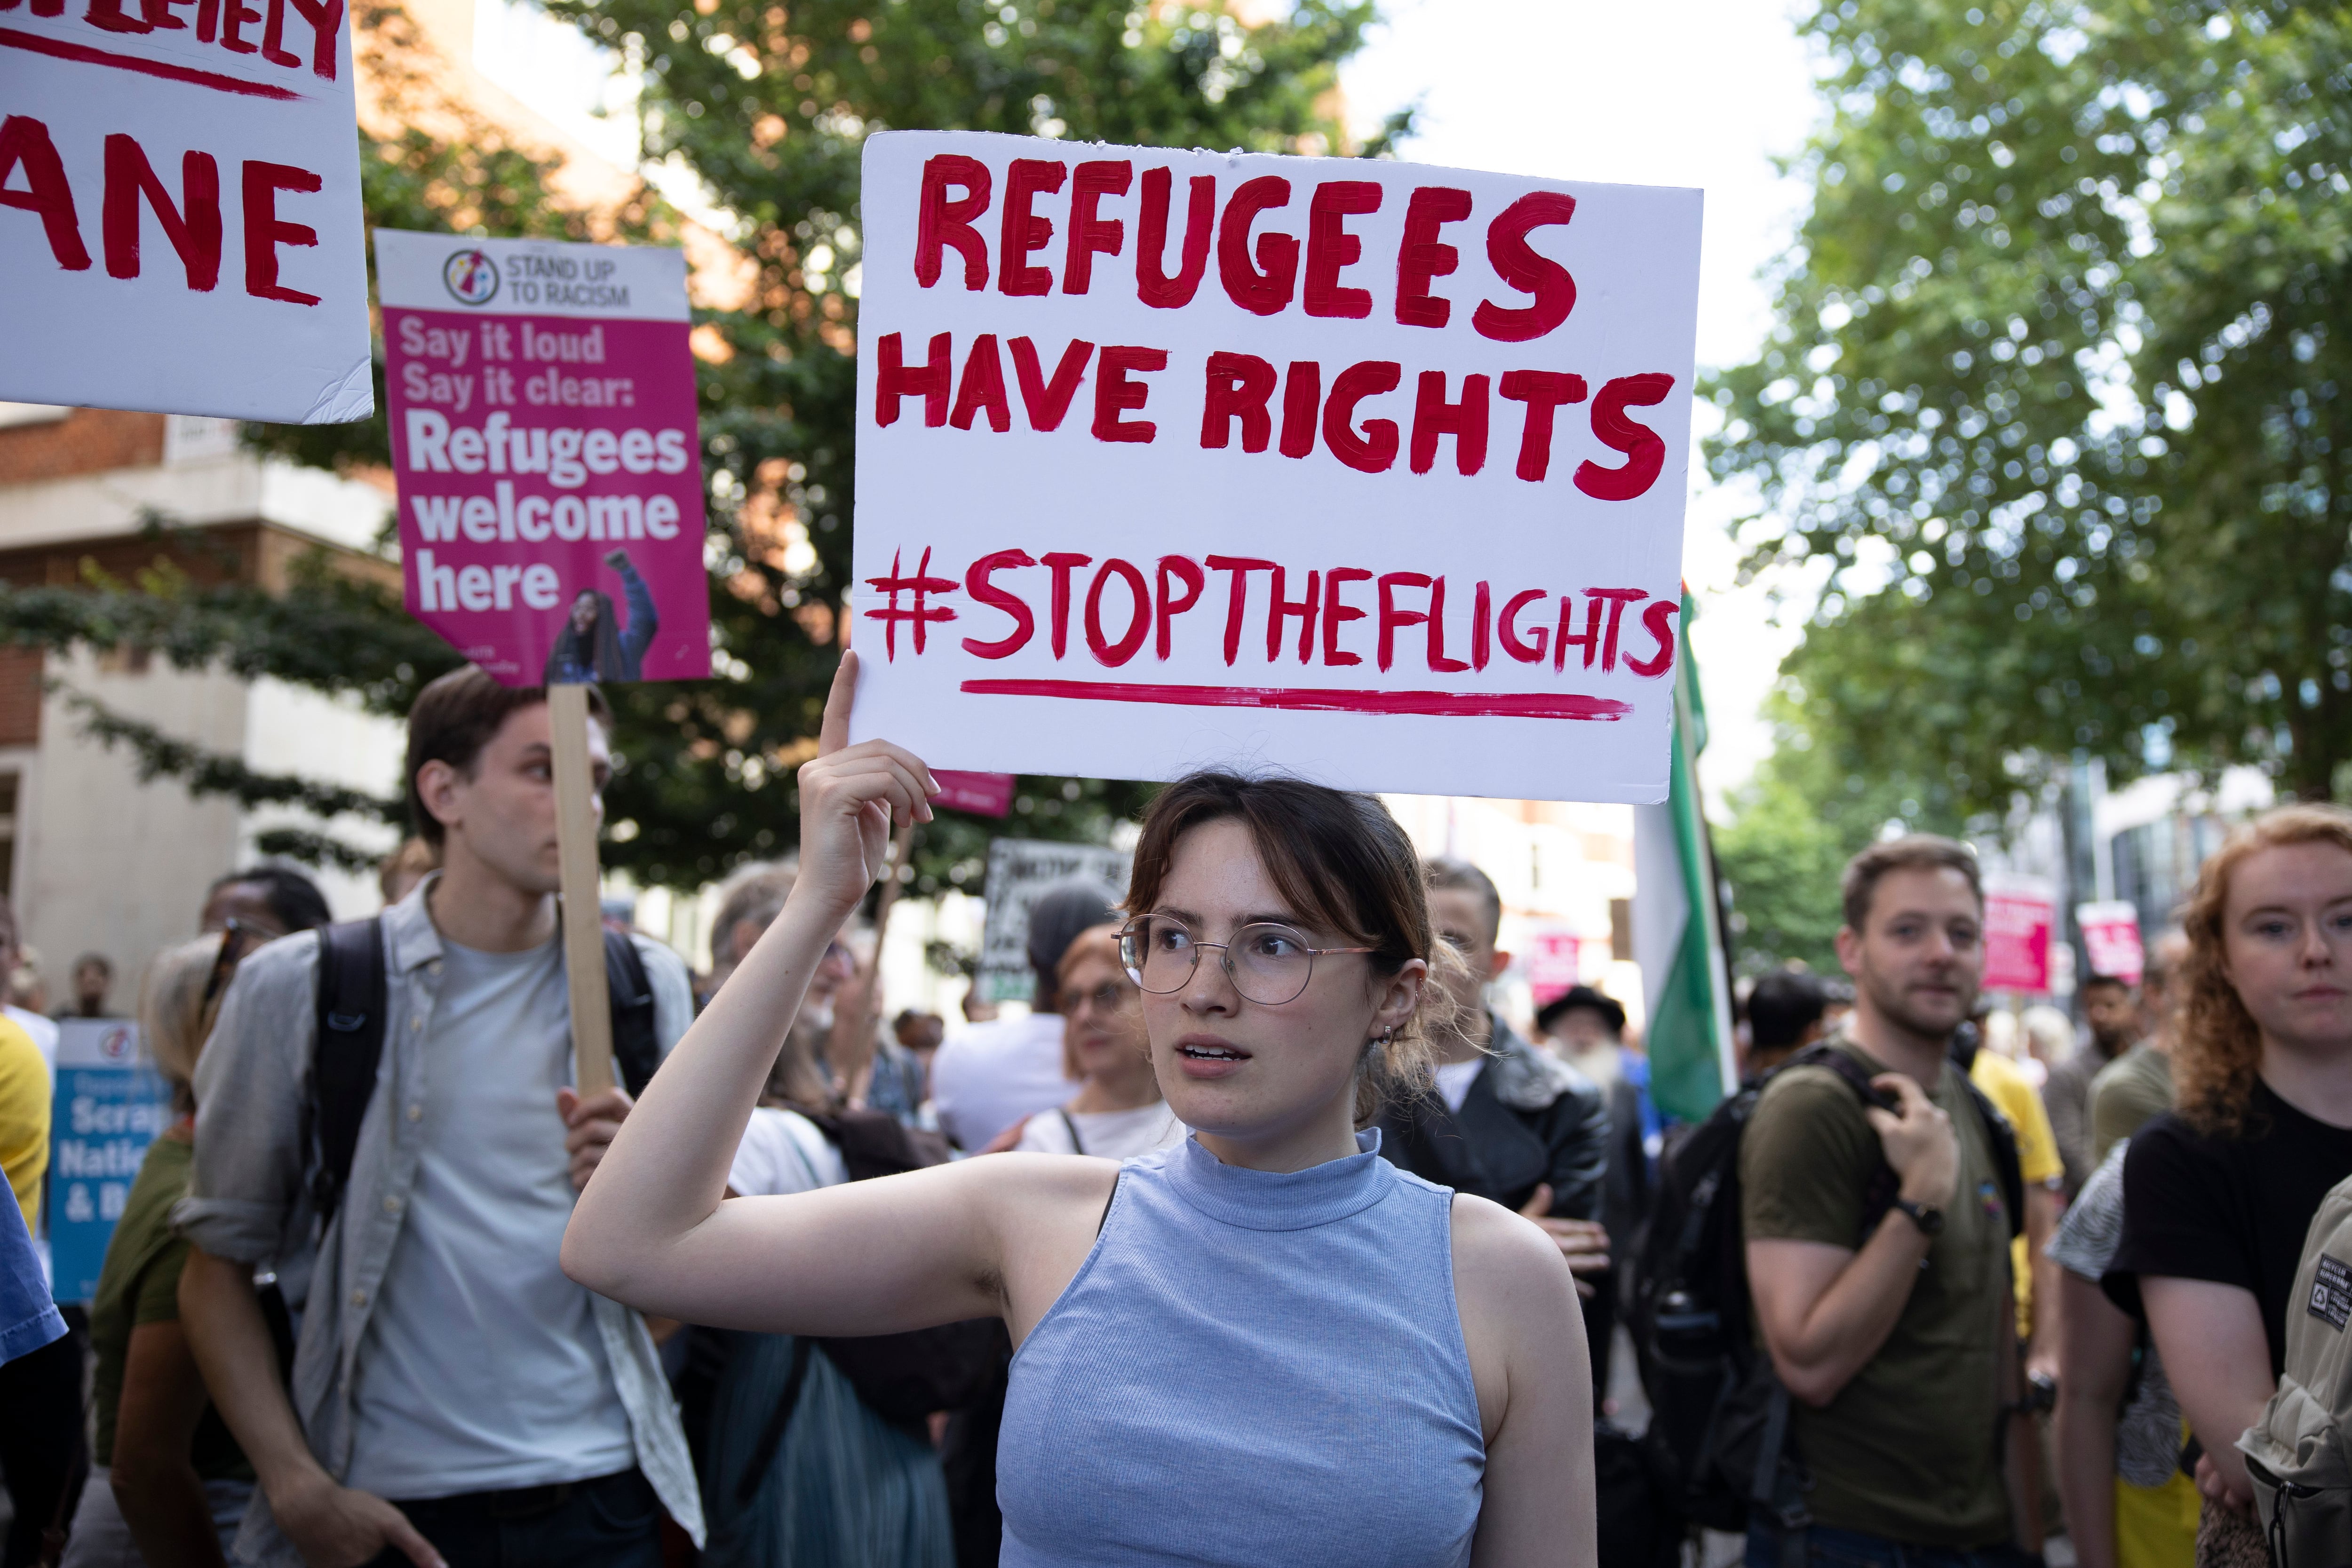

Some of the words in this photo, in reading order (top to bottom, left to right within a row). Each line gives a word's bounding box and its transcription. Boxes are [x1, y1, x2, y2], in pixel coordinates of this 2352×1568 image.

[506, 254, 578, 279] STAND
[584, 259, 616, 281] UP
[914, 154, 1577, 342] REFUGEES
[509, 281, 539, 303] TO
[544, 282, 630, 307] RACISM
[399, 316, 471, 367] Say
[480, 321, 513, 362] it
[521, 322, 605, 364] loud
[403, 362, 474, 413] Say
[484, 366, 516, 405] it
[524, 367, 635, 407] clear:
[875, 331, 1168, 444] HAVE
[1201, 351, 1675, 501] RIGHTS
[405, 408, 688, 488] Refugees
[411, 479, 680, 543] welcome
[416, 549, 560, 612] here
[865, 546, 1679, 678] #STOPTHEFLIGHTS
[65, 1181, 94, 1222] &
